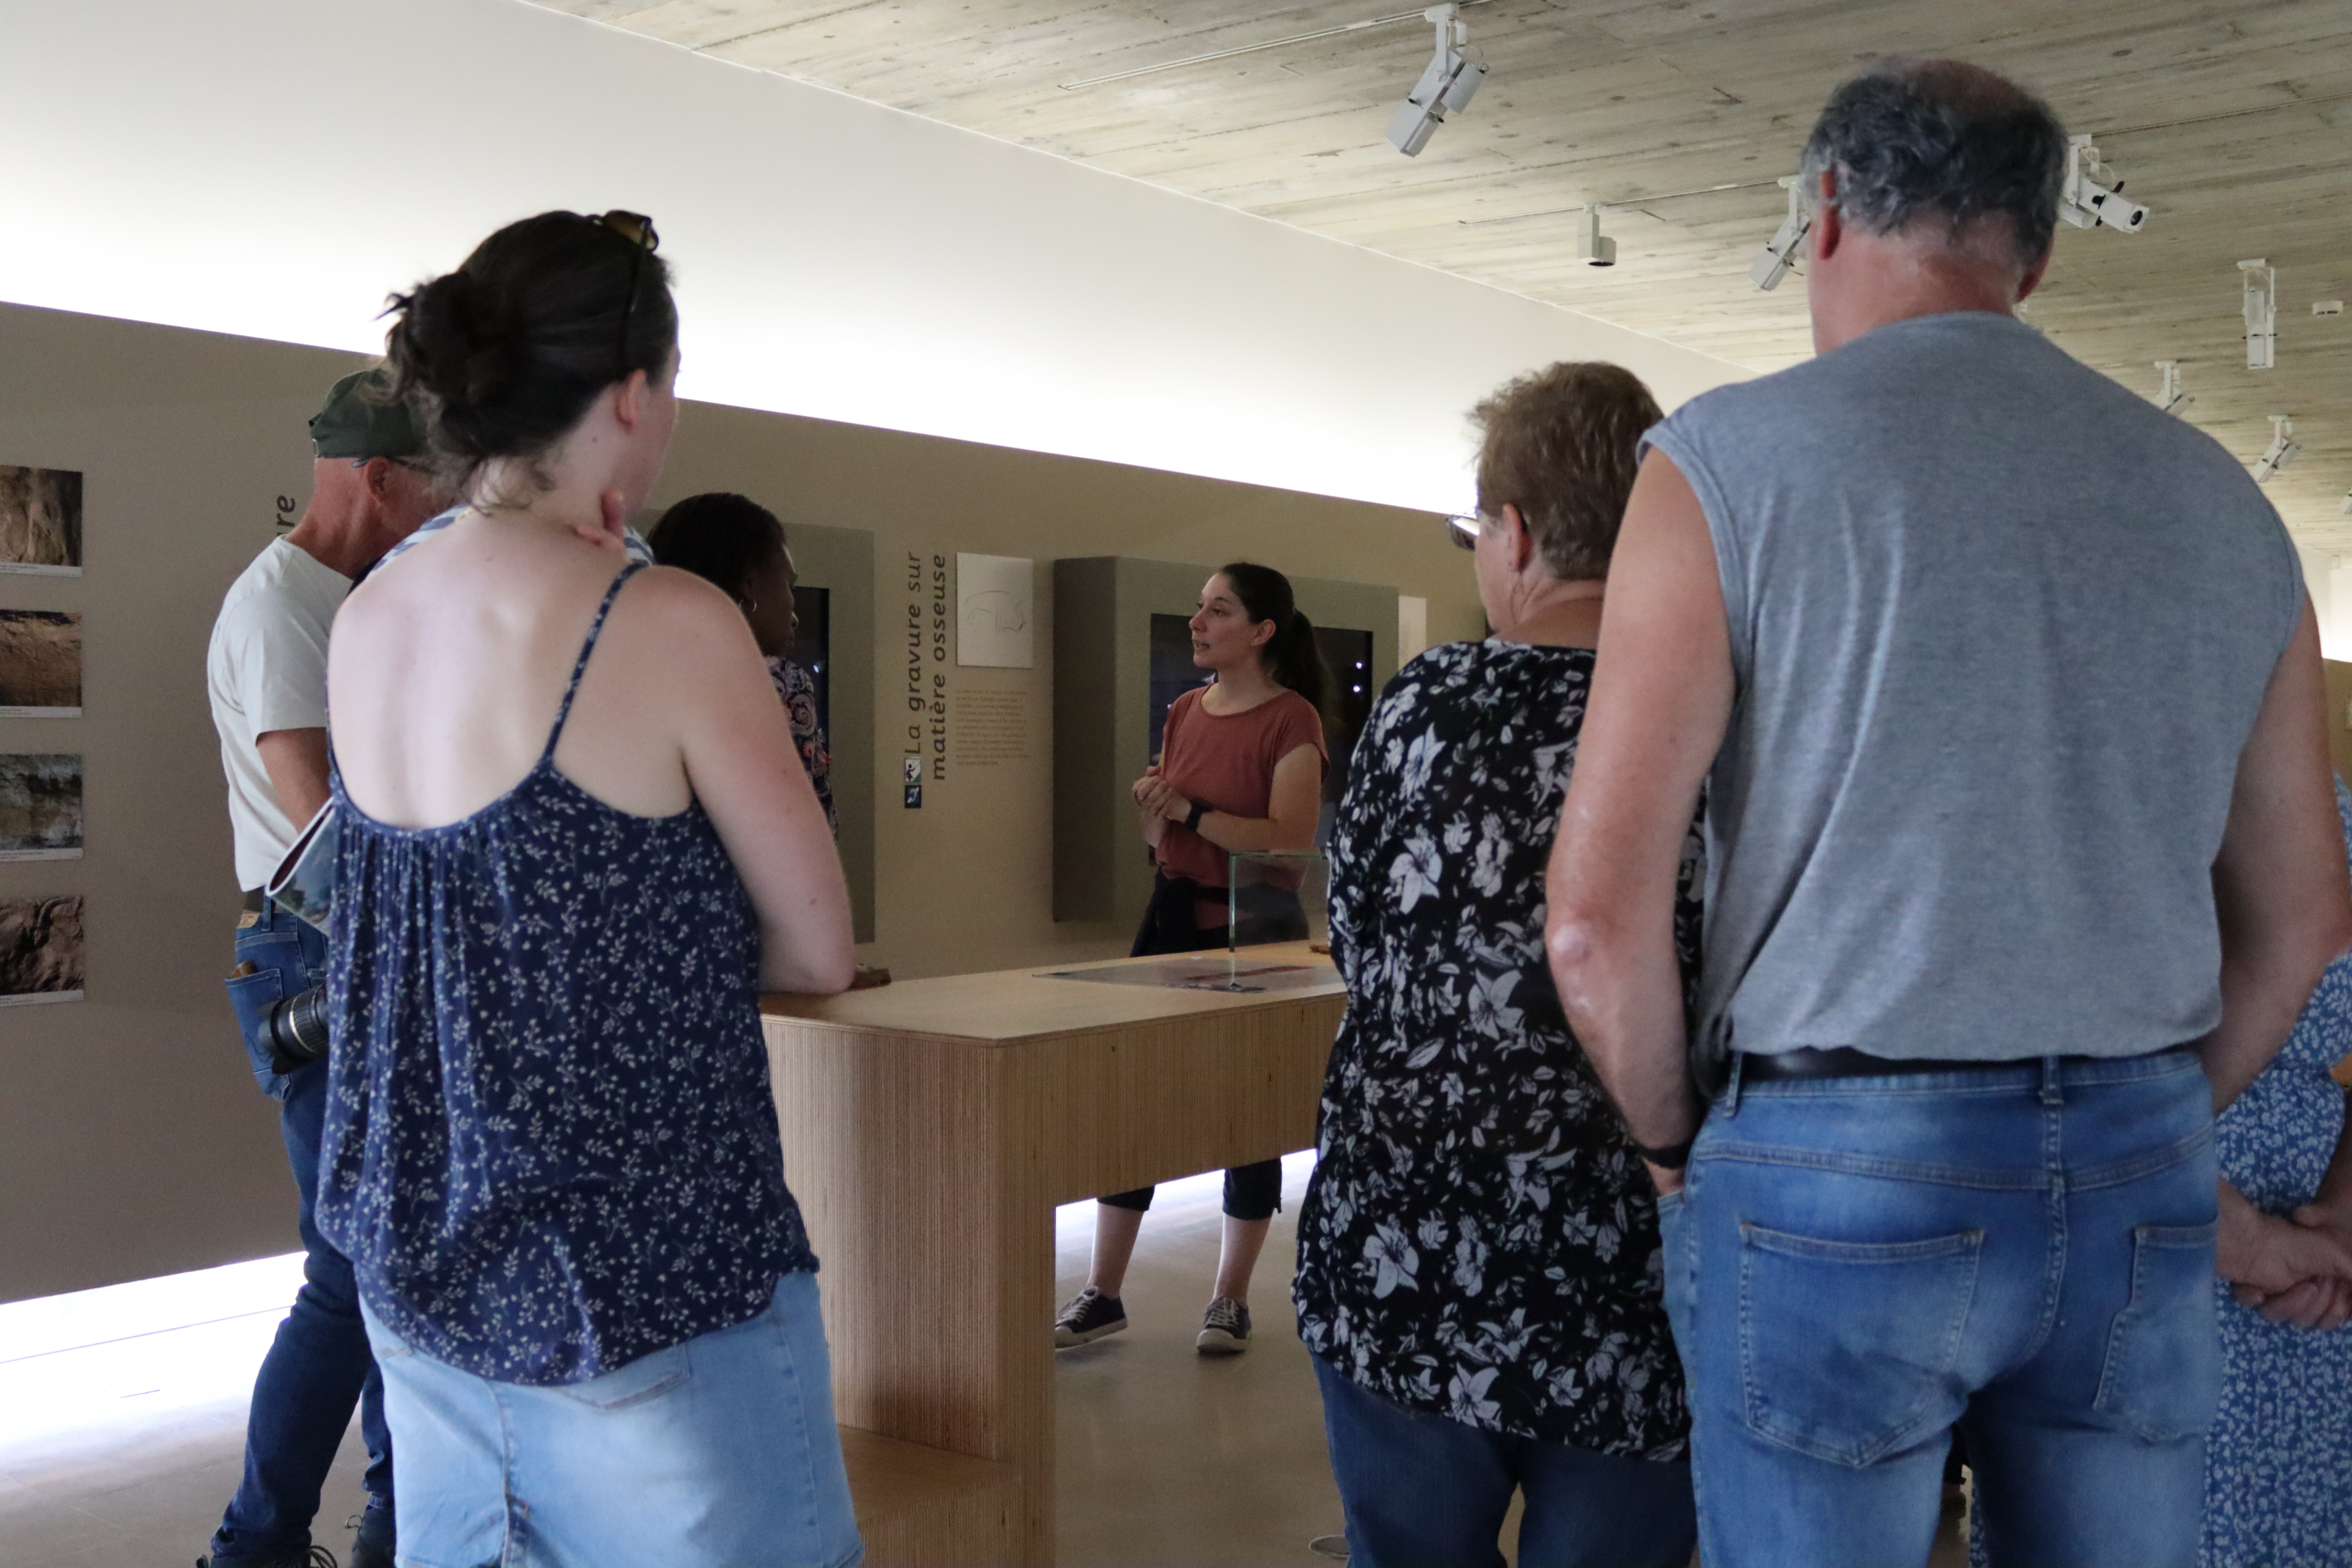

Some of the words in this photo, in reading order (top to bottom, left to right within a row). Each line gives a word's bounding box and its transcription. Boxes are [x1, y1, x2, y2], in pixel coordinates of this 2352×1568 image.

[276, 495, 295, 536] re
[908, 551, 921, 593] sur
[933, 554, 946, 662] osseuse
[908, 604, 926, 712] gravure
[905, 725, 921, 754] La
[929, 674, 946, 780] matière
